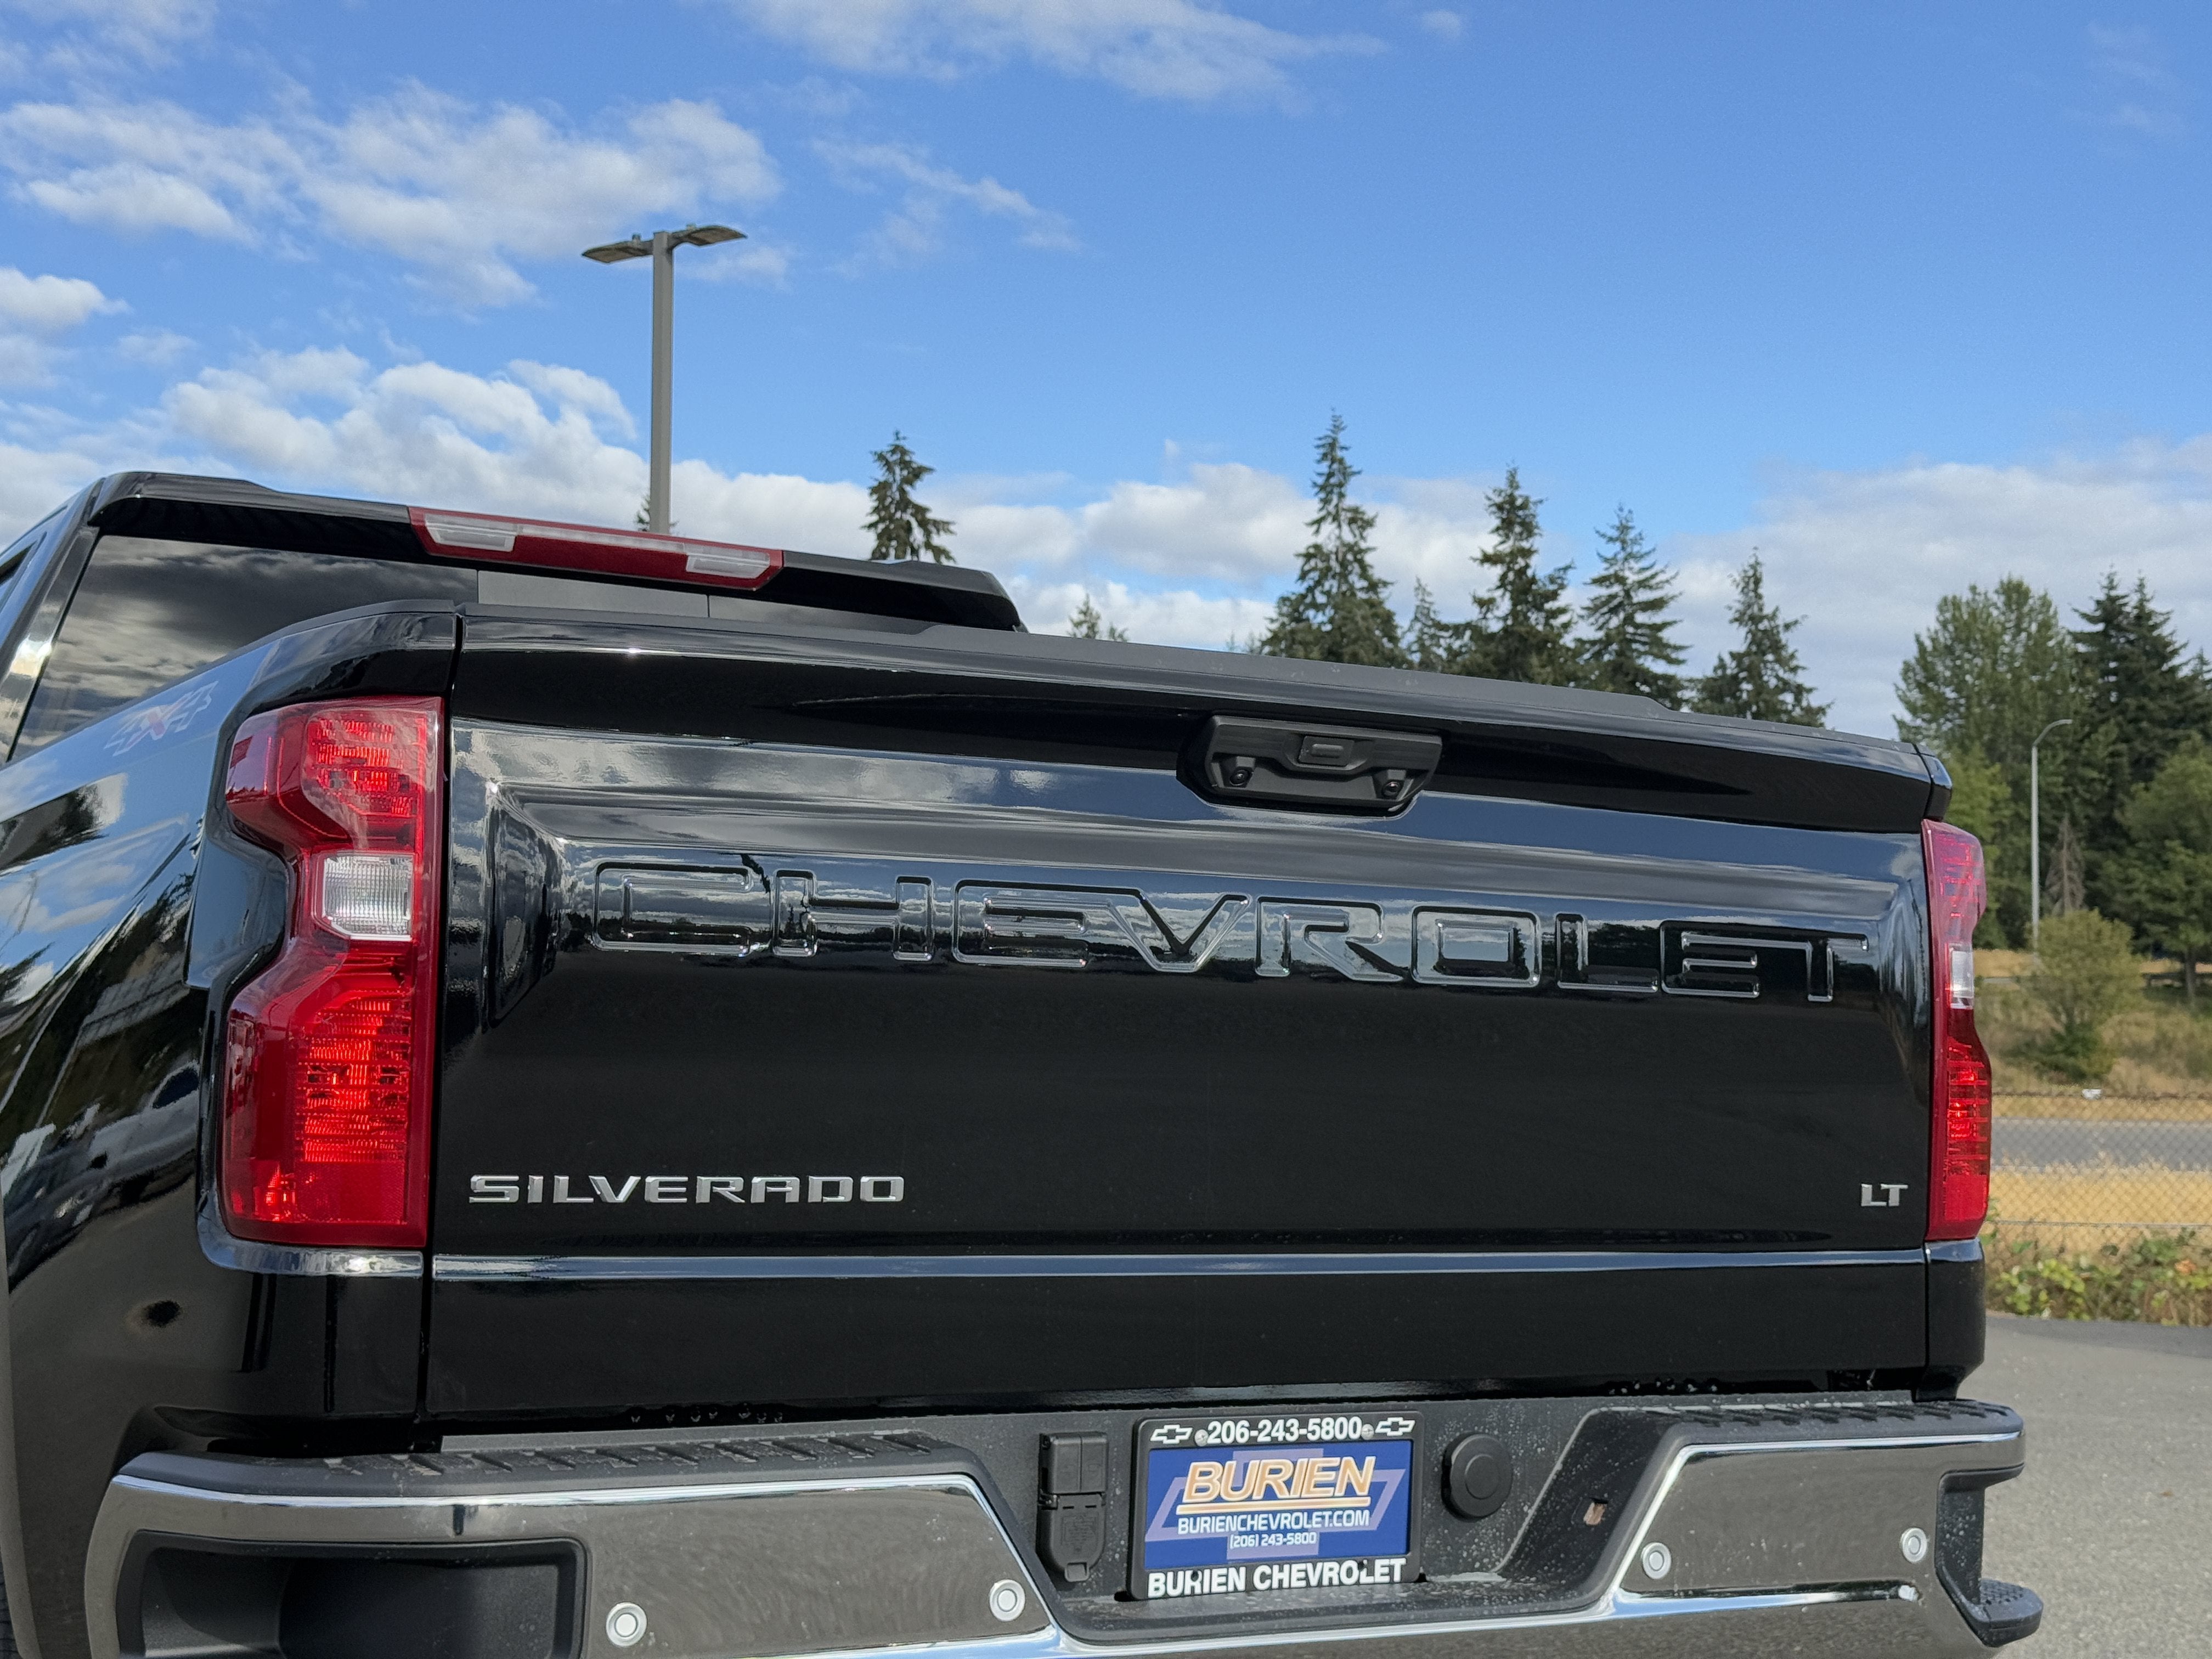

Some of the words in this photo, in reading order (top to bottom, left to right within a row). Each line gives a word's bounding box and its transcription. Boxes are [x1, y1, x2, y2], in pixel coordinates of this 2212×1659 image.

[593, 860, 1869, 1004] CHEVROLET
[469, 1175, 905, 1204] SILVERADO
[1861, 1183, 1909, 1207] LT
[1207, 1417, 1363, 1444] 206-243-5800
[1182, 1455, 1376, 1503] BURIEN
[1177, 1509, 1370, 1535] BURIENCHEVROLET.COM
[1229, 1533, 1260, 1549] (206)
[1261, 1532, 1317, 1547] 243-5800
[1148, 1566, 1247, 1598] BURIEN
[1252, 1557, 1407, 1590] CHEVROLET
